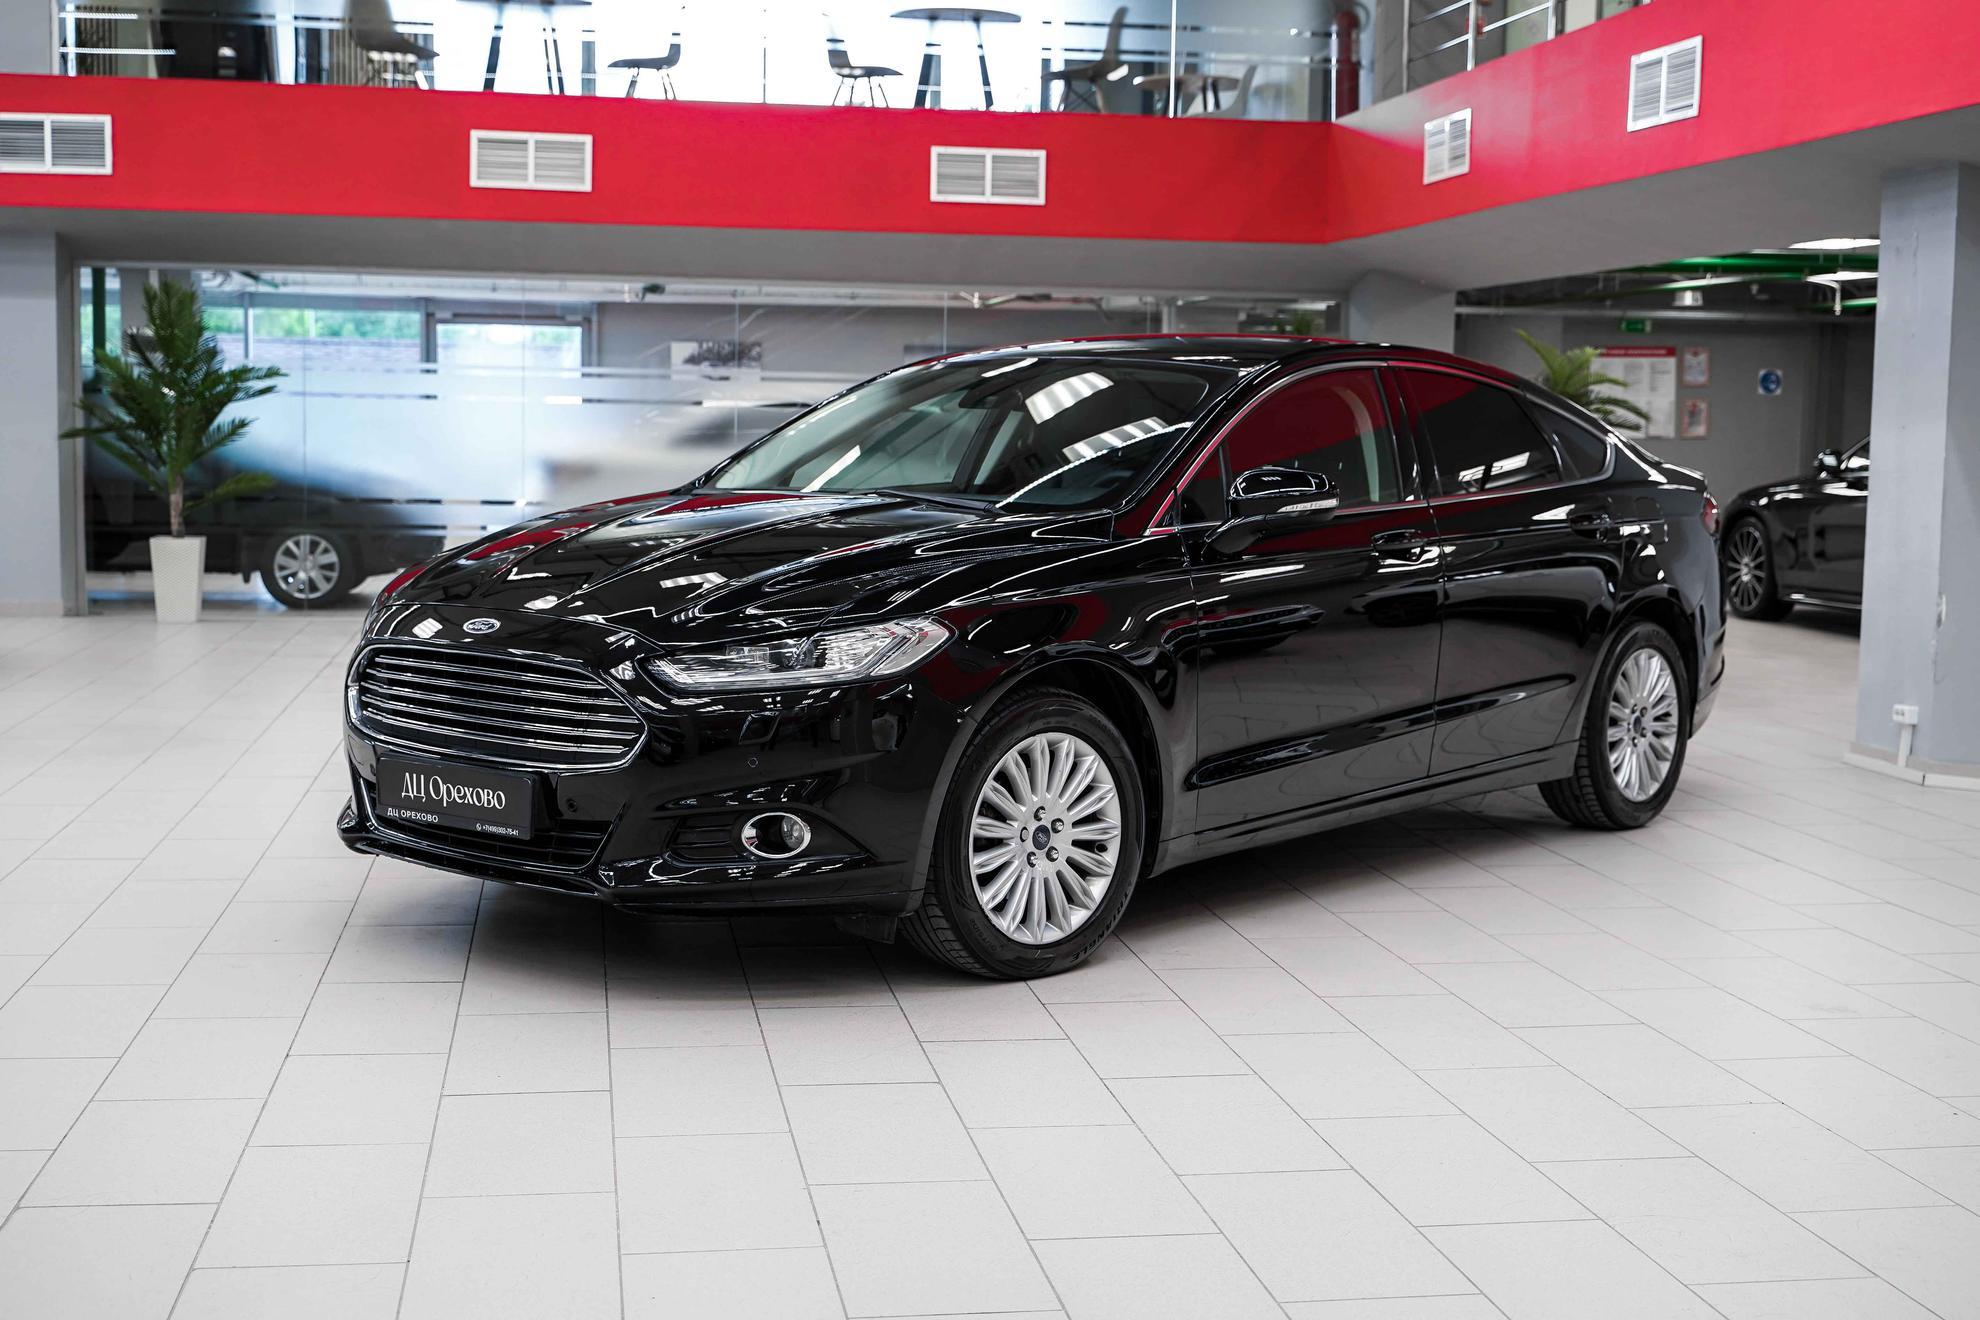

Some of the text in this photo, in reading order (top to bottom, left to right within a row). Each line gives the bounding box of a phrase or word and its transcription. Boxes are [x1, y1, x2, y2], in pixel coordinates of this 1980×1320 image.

[401, 772, 505, 809] ДЦ Орехово
[387, 807, 439, 823] ДЦ ОРЕХОВО
